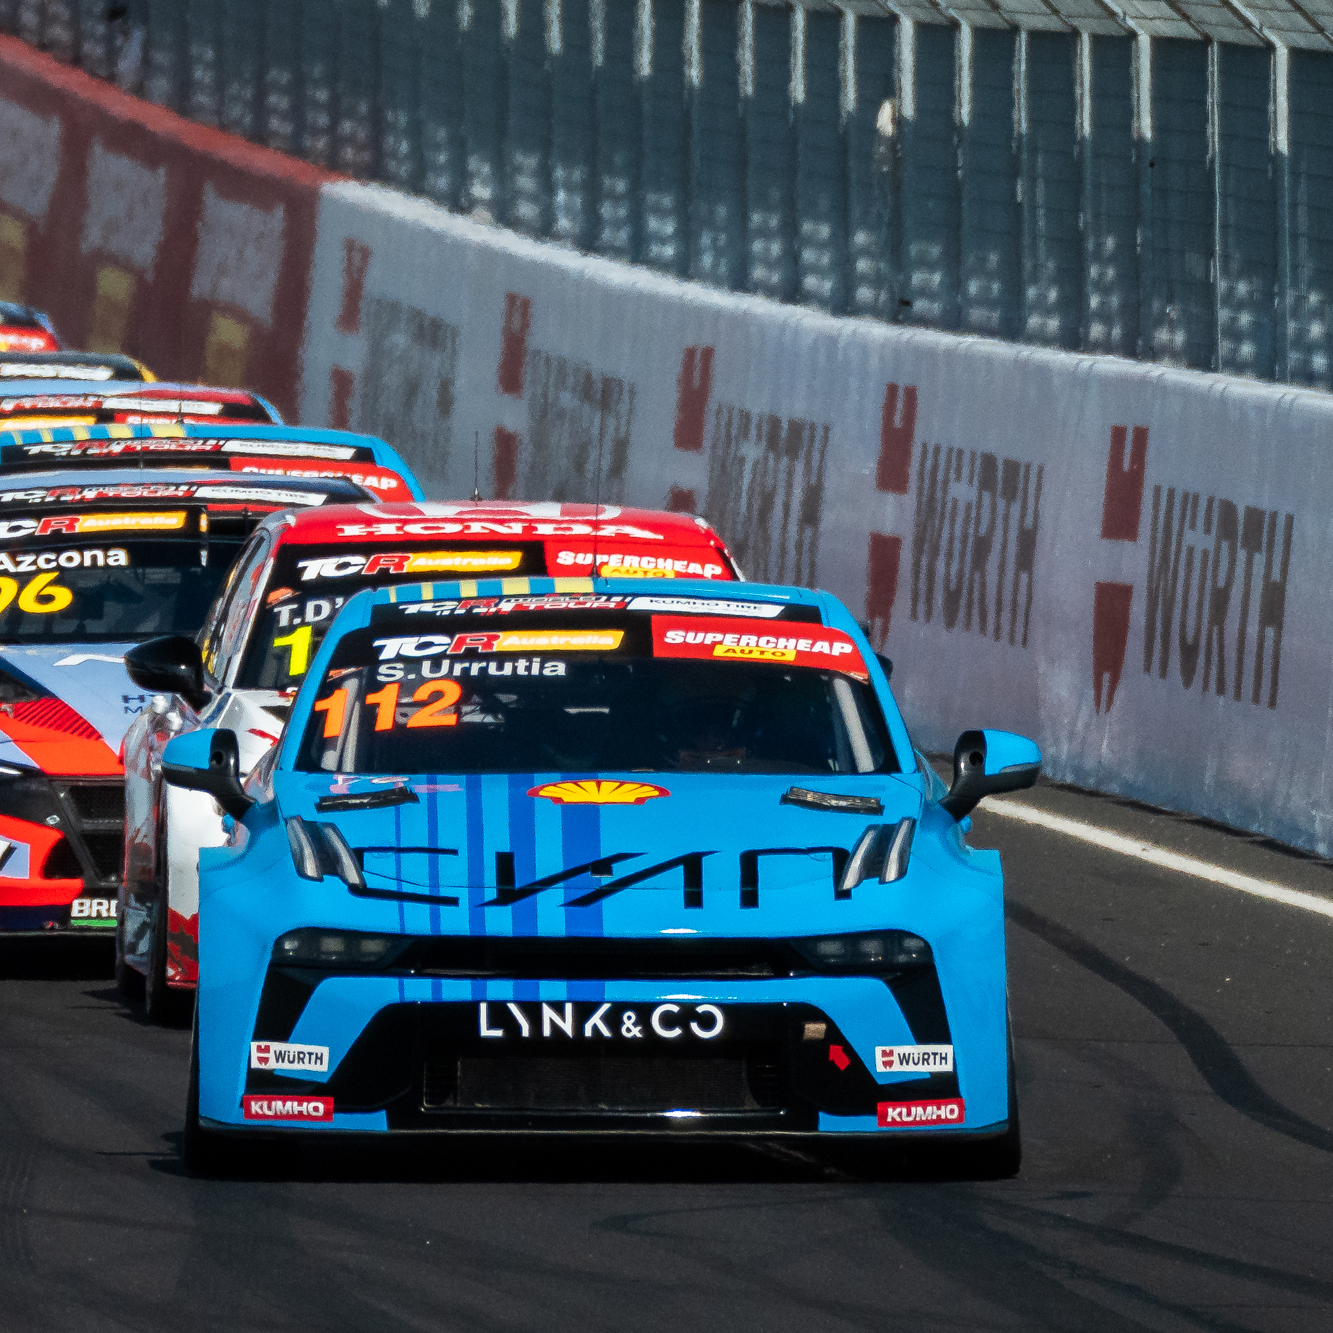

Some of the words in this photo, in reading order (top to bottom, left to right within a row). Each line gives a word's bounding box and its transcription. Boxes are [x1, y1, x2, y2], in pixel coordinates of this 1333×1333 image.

[82, 514, 180, 530] Australia
[336, 522, 665, 540] HONDA
[296, 553, 413, 581] TCR
[412, 554, 513, 570] Australia
[556, 550, 723, 578] SUPERCHEAP
[647, 598, 719, 610] KUMHO
[723, 602, 765, 612] TIRE
[1143, 484, 1296, 710] WÜRTH
[373, 632, 504, 660] TCR
[502, 634, 616, 650] Australia
[664, 629, 854, 657] SUPERCHEAP
[718, 647, 788, 658] AUTO
[376, 656, 567, 683] S.Urrutia
[314, 679, 463, 739] 112
[273, 1050, 325, 1066] WÜRTH
[897, 1051, 949, 1066] WÜRTH
[250, 1100, 325, 1118] KUMHO
[886, 1104, 960, 1123] KUMHO
